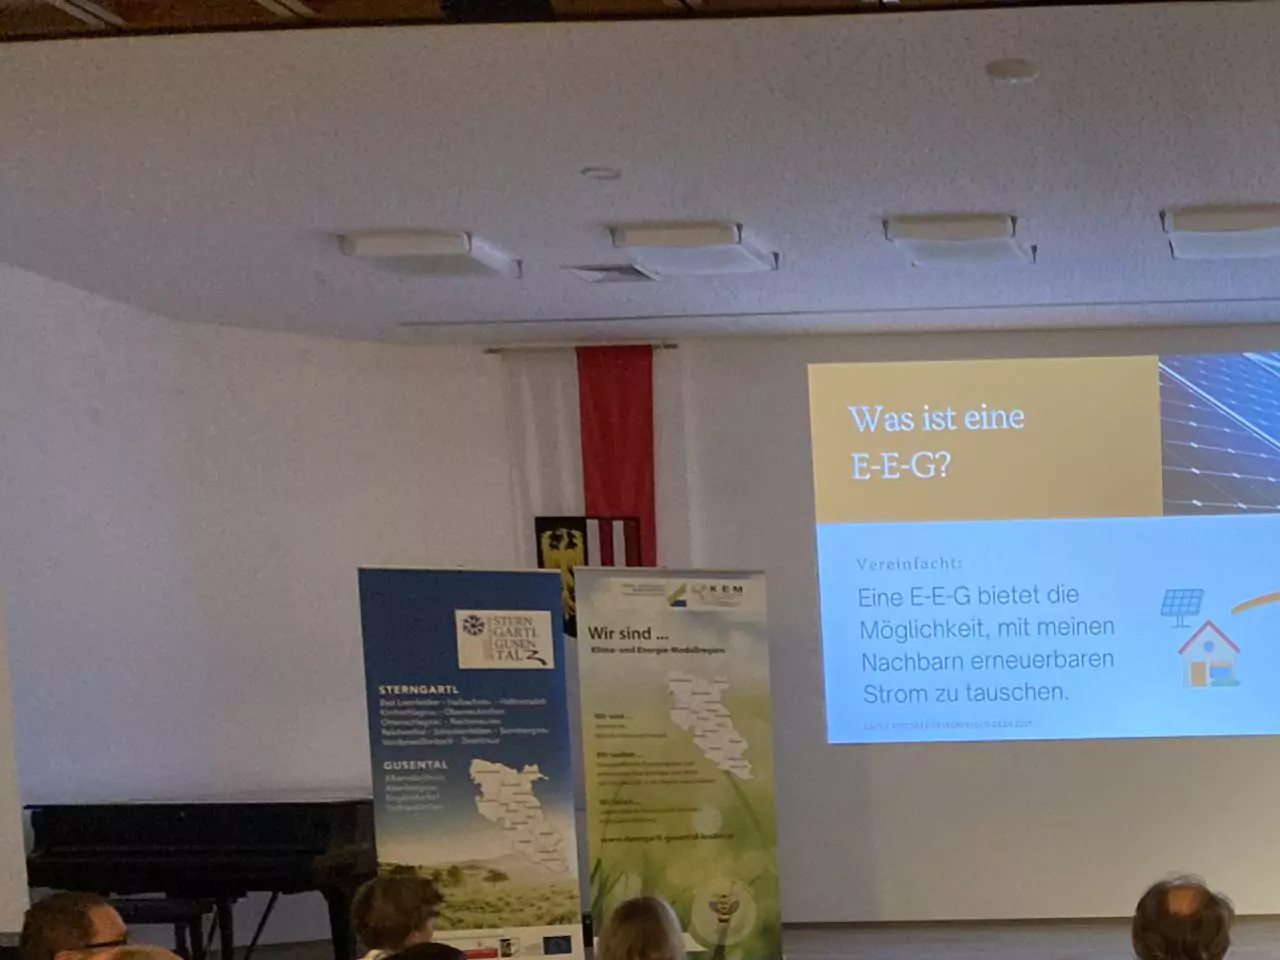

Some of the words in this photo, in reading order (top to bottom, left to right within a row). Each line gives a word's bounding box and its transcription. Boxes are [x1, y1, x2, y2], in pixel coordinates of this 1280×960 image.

[848, 405, 914, 432] Was
[922, 404, 957, 431] ist
[964, 402, 1025, 430] eine
[851, 450, 951, 480] E-E-G?
[856, 556, 962, 571] Vereinfacht:
[858, 587, 903, 607] Eine
[910, 585, 970, 606] E-E-G
[978, 584, 1041, 605] bietet
[1047, 583, 1079, 604] die
[588, 626, 615, 640] Wir
[619, 626, 652, 640] sind
[860, 618, 990, 644] Möglichkeit,
[998, 617, 1030, 637] mit
[1037, 616, 1114, 636] meinen
[862, 652, 963, 672] Nachbarn
[971, 650, 1114, 670] erneuerbaren
[378, 685, 459, 695] STERNGARTL
[864, 683, 928, 704] Strom
[935, 687, 958, 703] zu
[966, 681, 1069, 702] tauschen.
[383, 760, 449, 770] GUSENTAL
